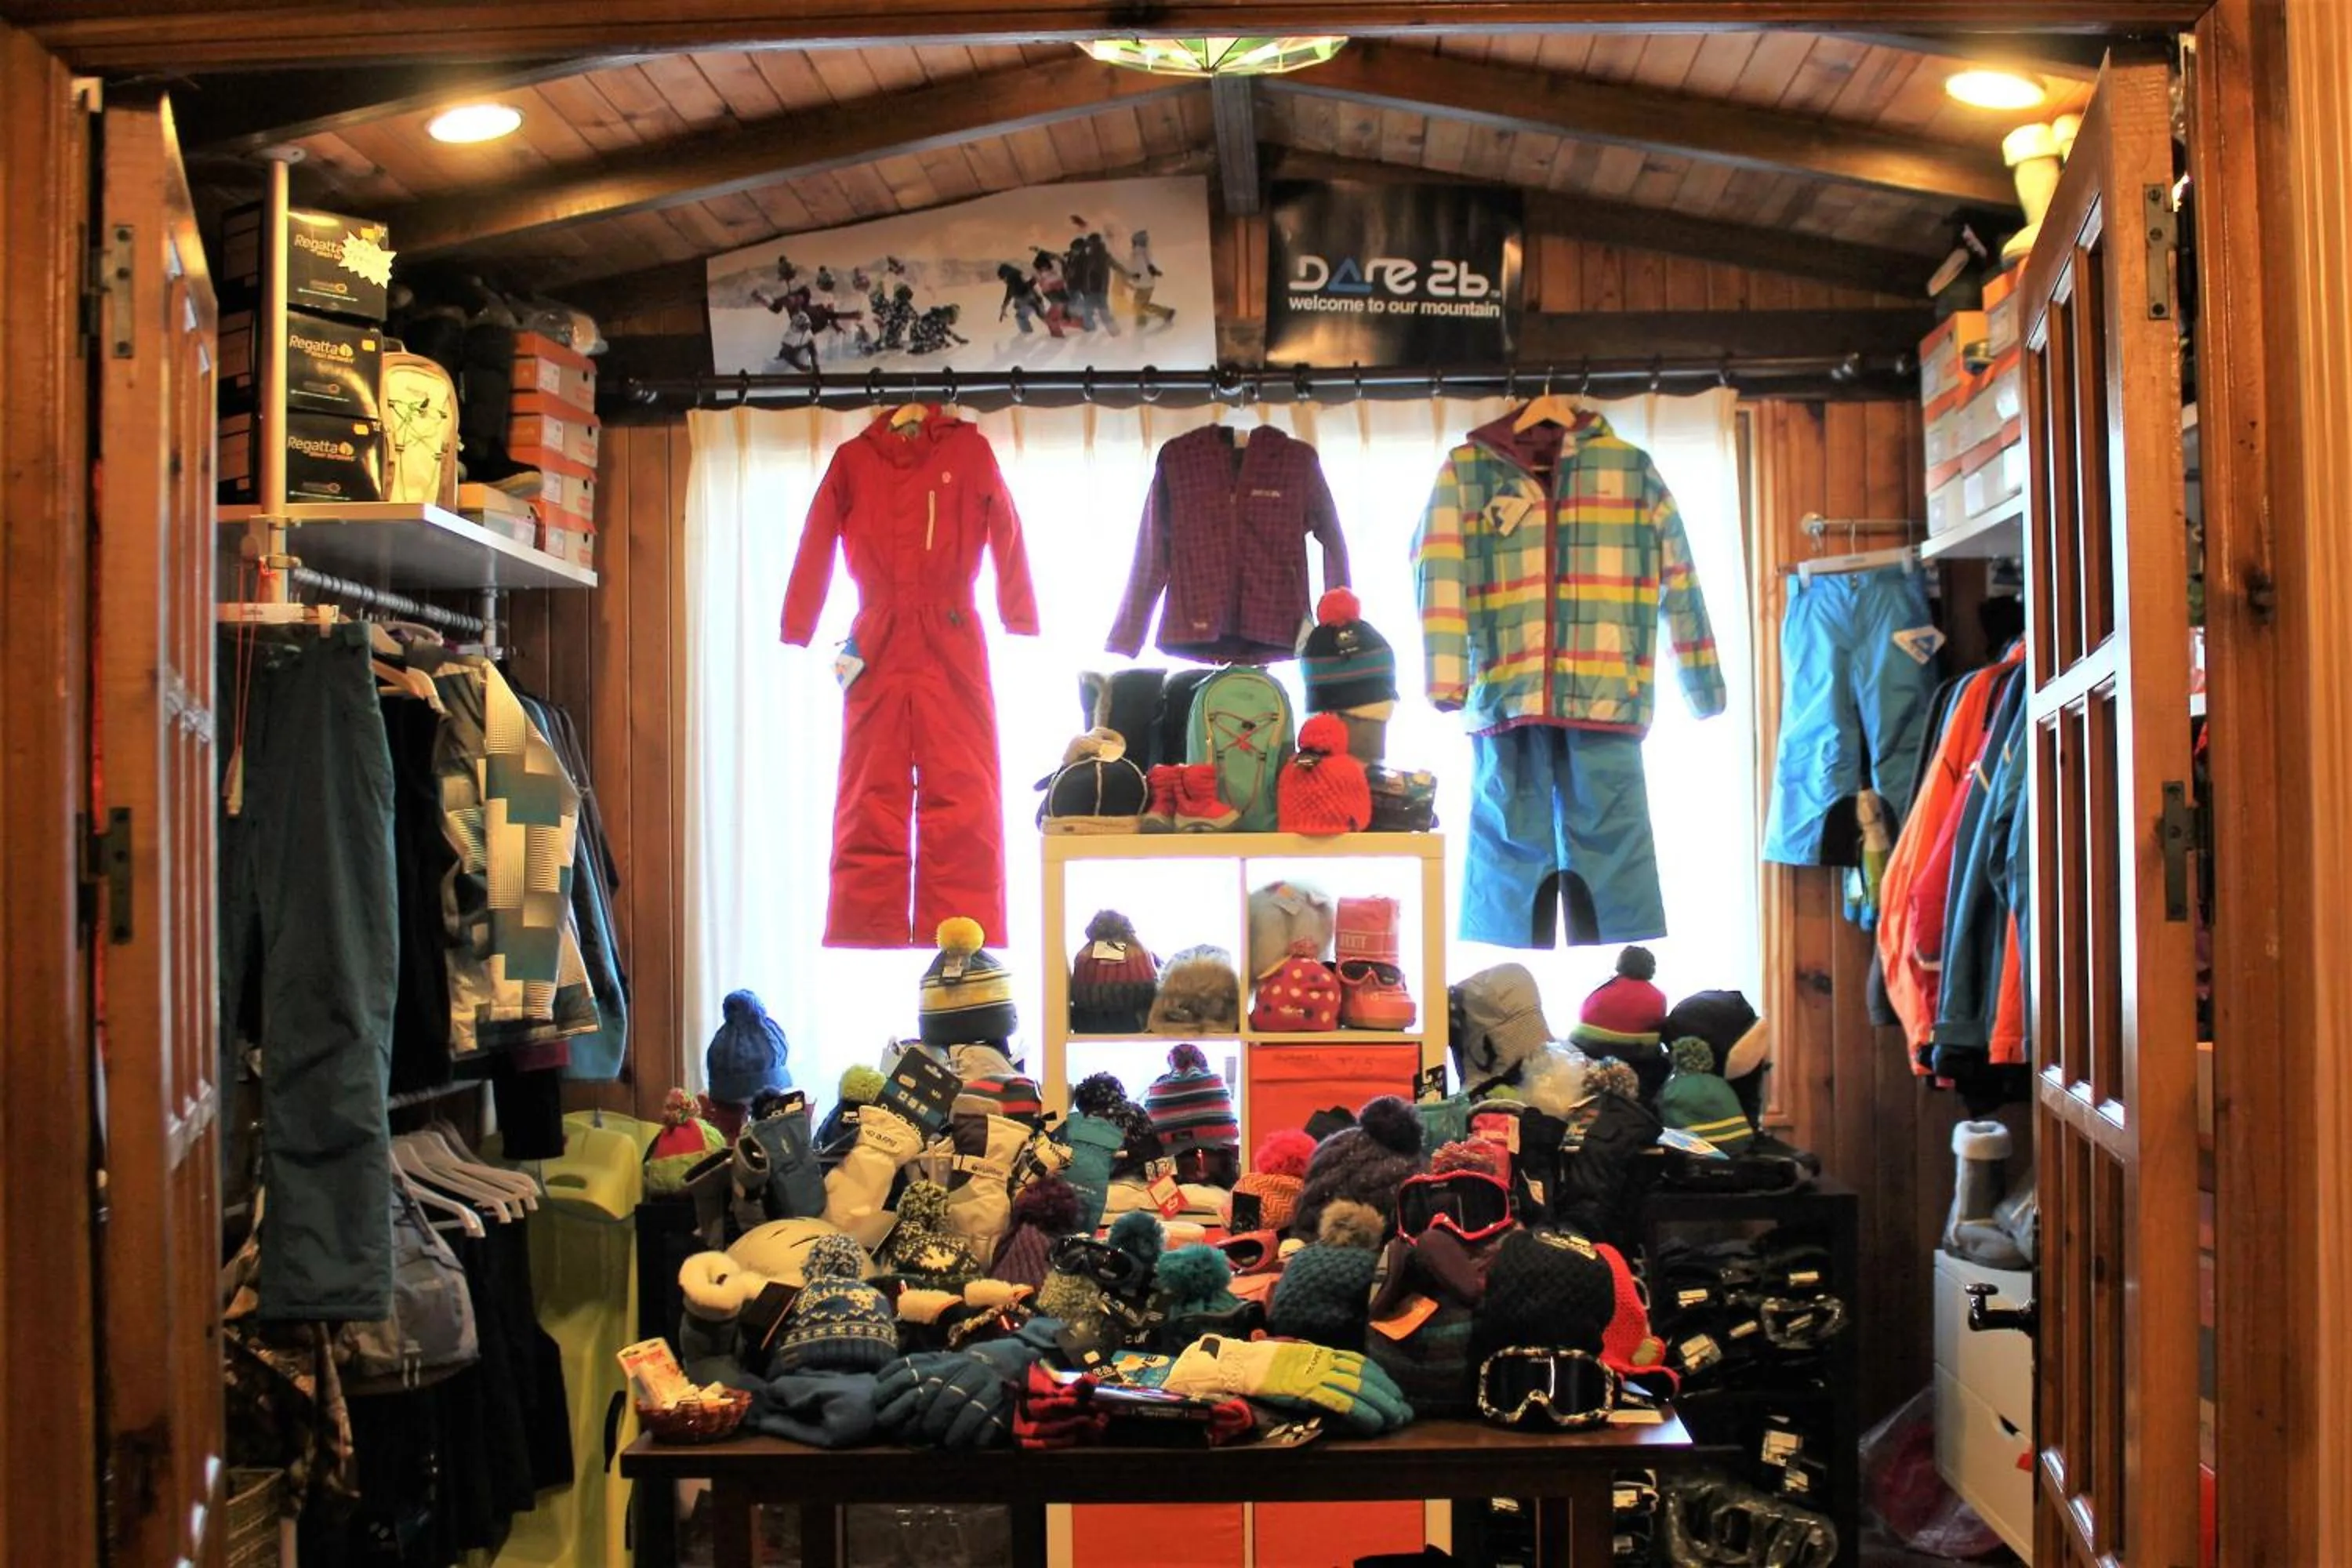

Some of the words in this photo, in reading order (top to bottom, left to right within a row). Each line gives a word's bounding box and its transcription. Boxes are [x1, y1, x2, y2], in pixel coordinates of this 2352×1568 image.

[1290, 295, 1364, 312] welcome
[1367, 298, 1385, 313] to
[1388, 301, 1419, 314] our
[1421, 301, 1501, 318] mountain
[289, 335, 339, 355] Regatta
[288, 436, 338, 455] Regatta
